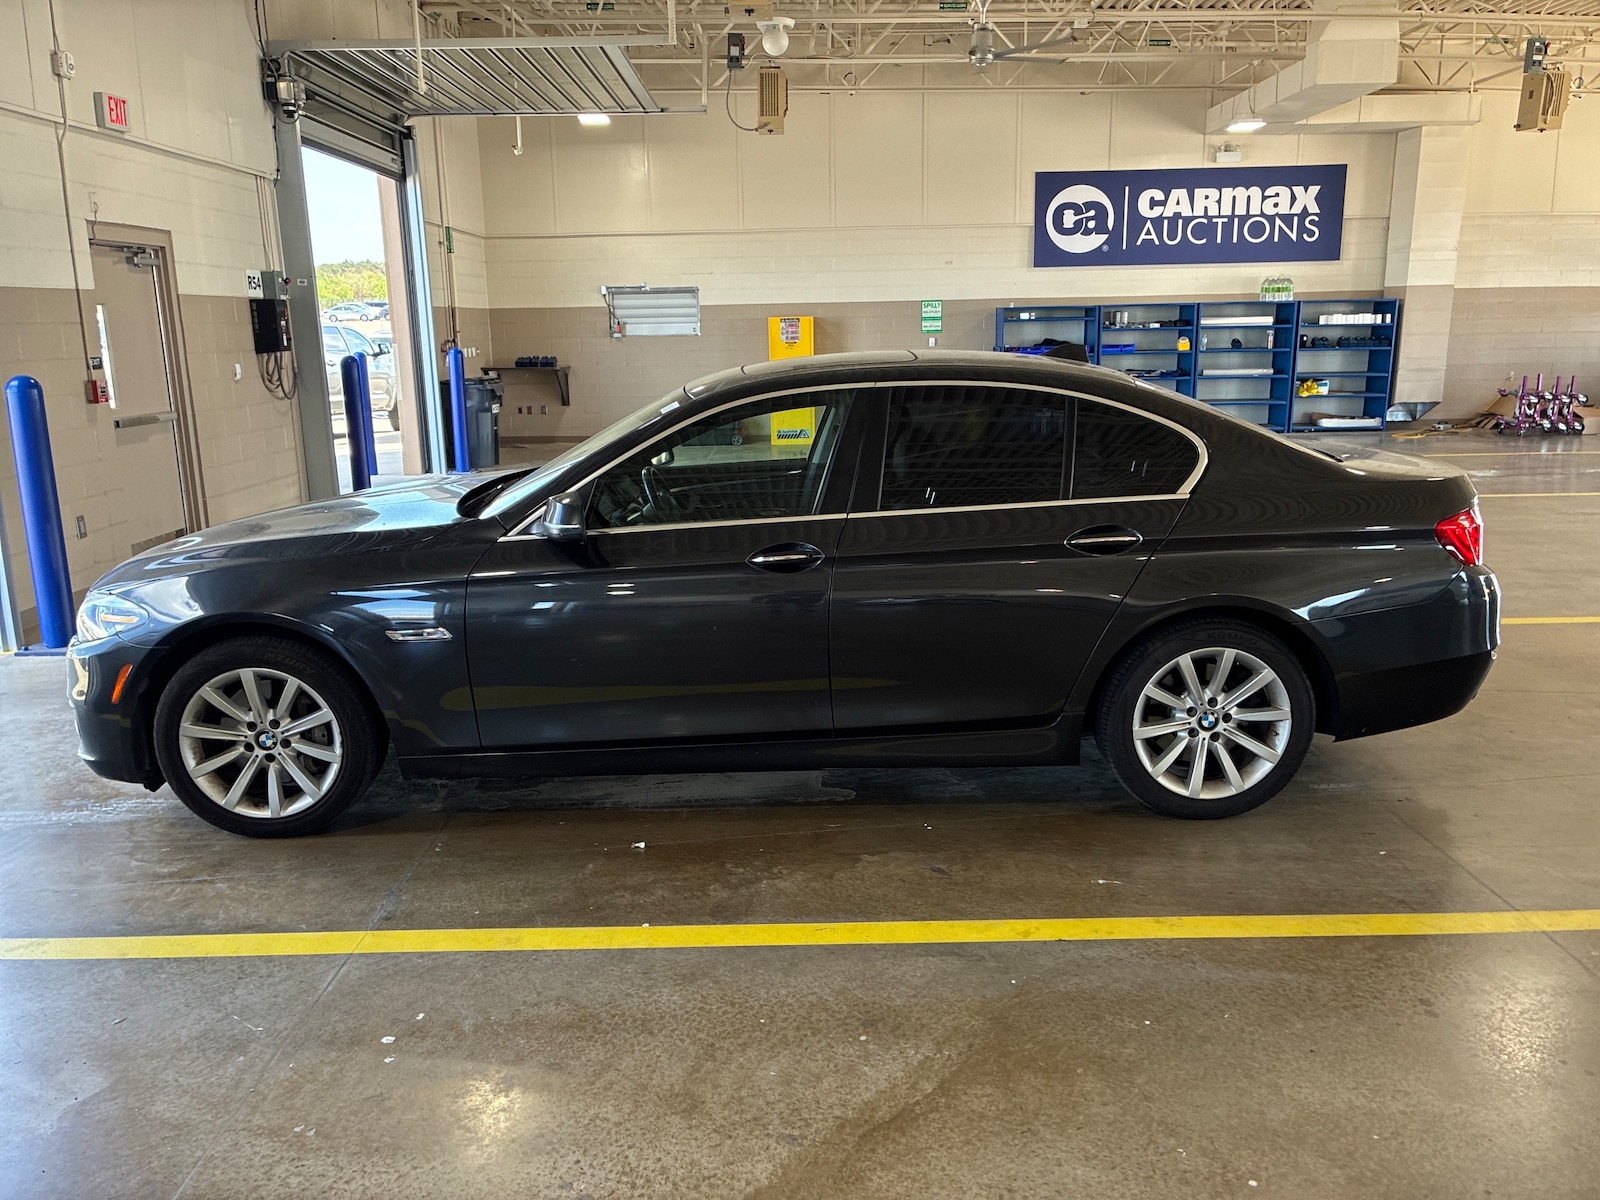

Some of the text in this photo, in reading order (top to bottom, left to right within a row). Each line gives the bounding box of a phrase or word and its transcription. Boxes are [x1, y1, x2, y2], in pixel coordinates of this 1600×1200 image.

[107, 95, 127, 127] EXIT
[1136, 215, 1320, 246] AUCTIONS
[247, 275, 262, 291] R54
